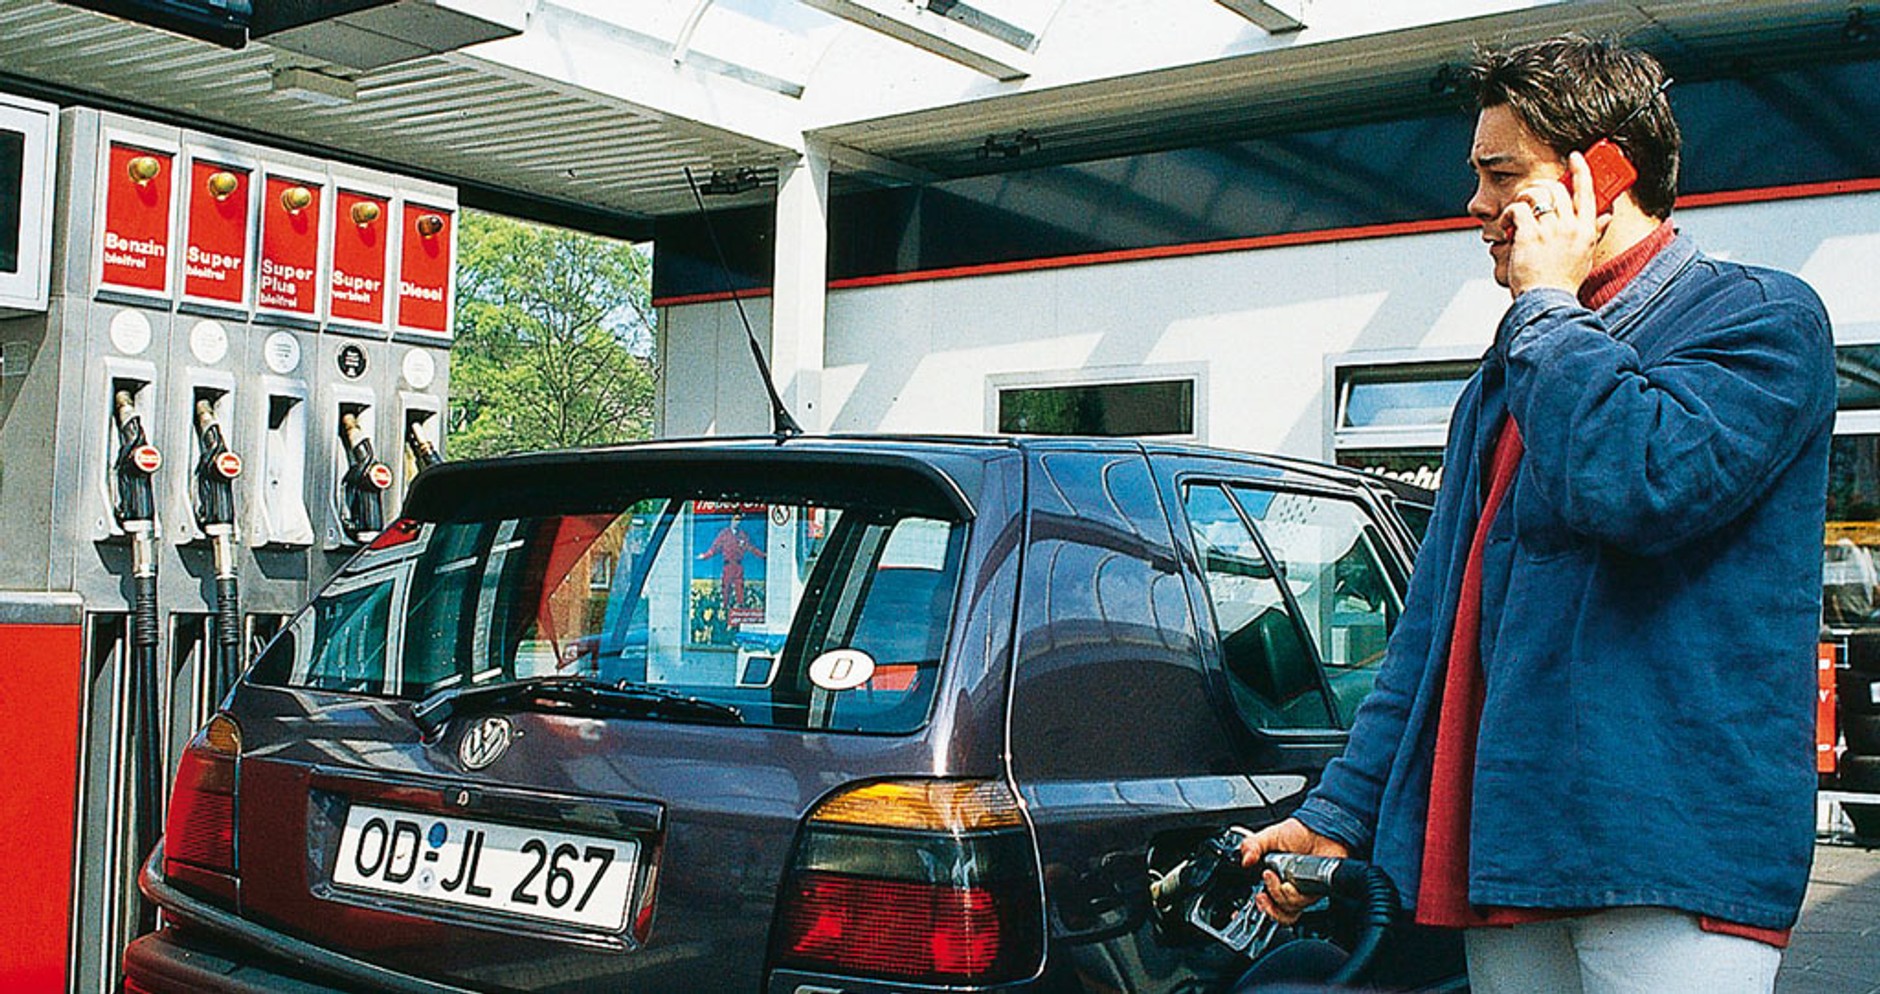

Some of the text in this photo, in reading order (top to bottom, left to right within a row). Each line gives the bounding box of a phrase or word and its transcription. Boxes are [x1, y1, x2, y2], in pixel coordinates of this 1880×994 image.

[105, 232, 165, 257] Benzin
[104, 252, 147, 269] bleifrei
[188, 246, 242, 270] Super
[186, 264, 226, 281] bleifrei
[262, 259, 314, 281] Super
[332, 270, 382, 292] Super
[262, 275, 297, 295] Plus
[399, 282, 443, 302] Diesel
[261, 292, 298, 308] bleifrei
[828, 657, 854, 681] D
[510, 839, 616, 912] 267
